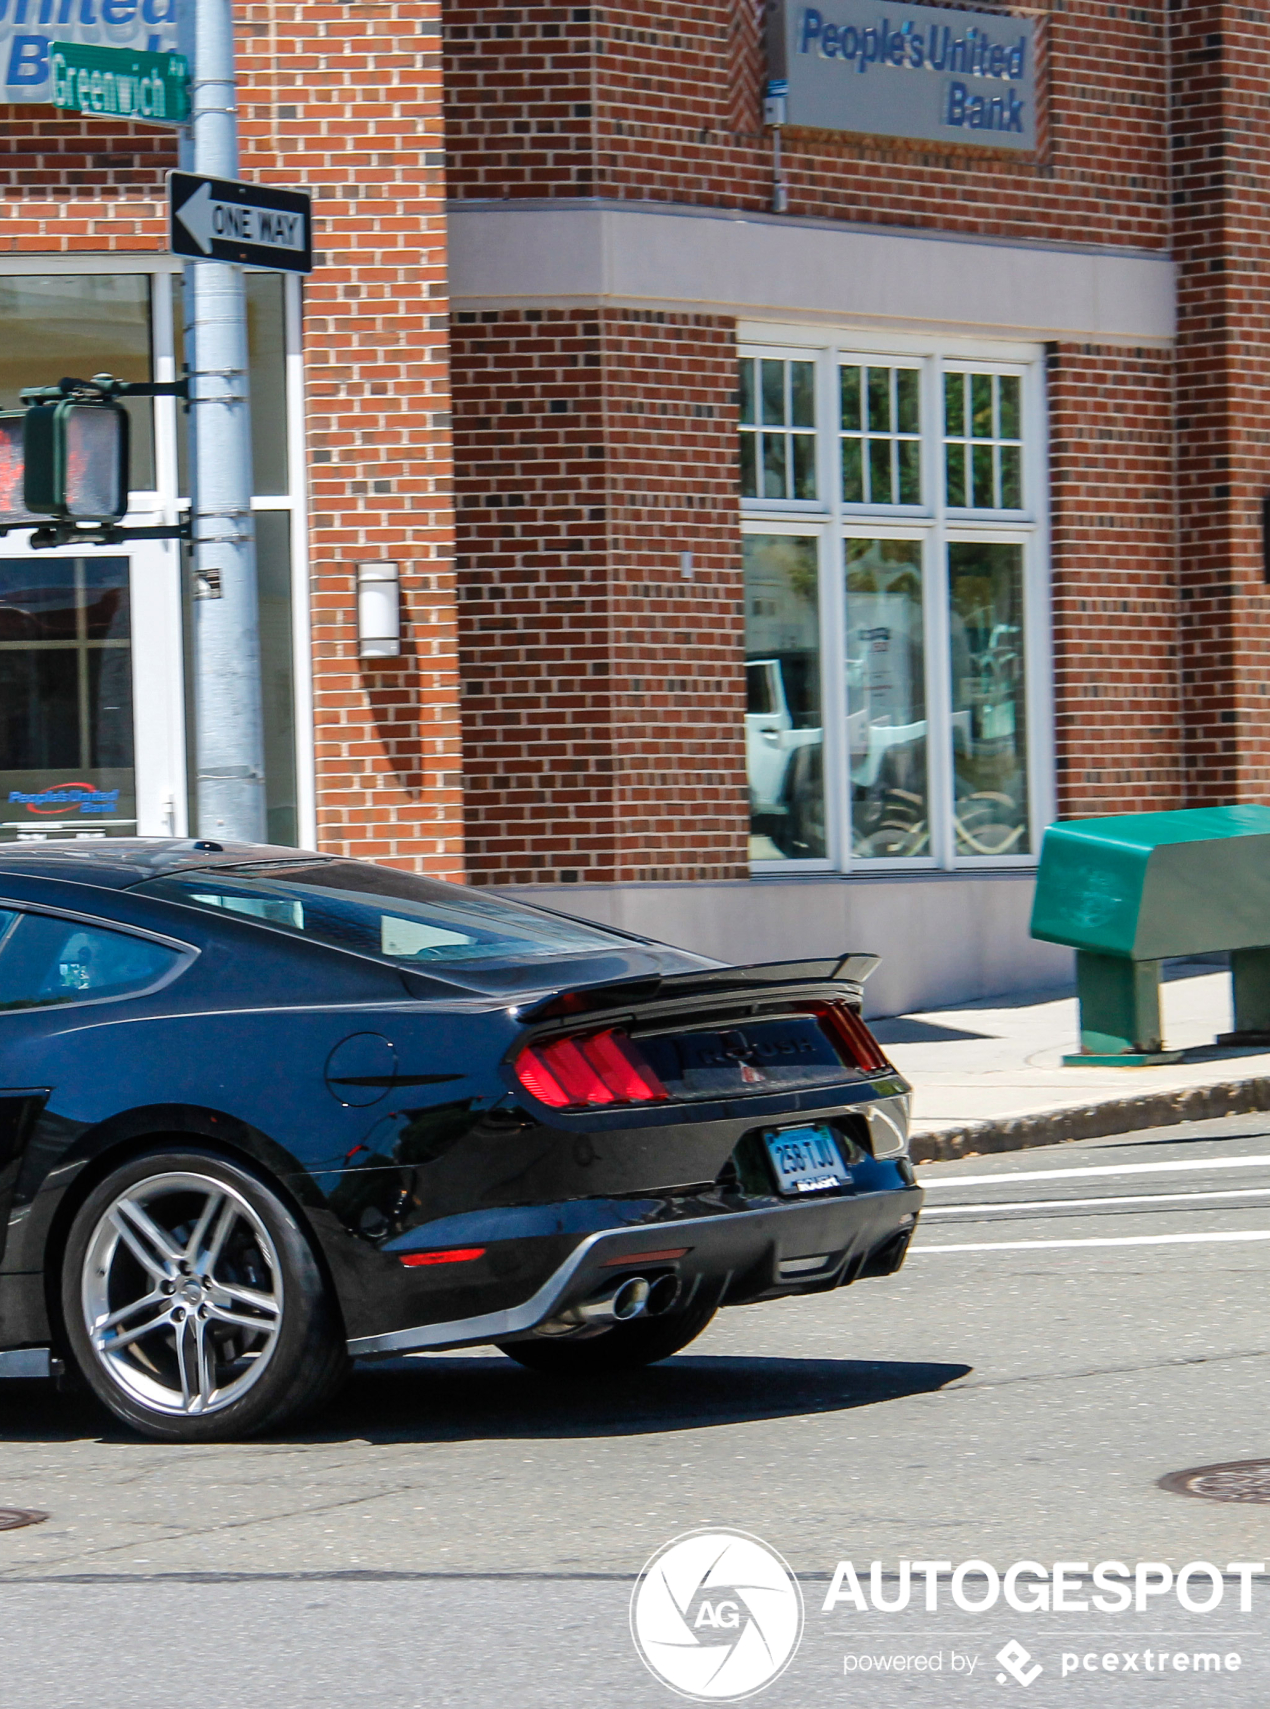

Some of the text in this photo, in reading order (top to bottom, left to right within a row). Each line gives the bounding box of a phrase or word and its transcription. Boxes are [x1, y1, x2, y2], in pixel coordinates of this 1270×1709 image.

[799, 8, 1026, 81] People's United
[54, 52, 166, 118] Greenwich
[945, 80, 1025, 133] Bank
[213, 205, 299, 245] ONE WAY
